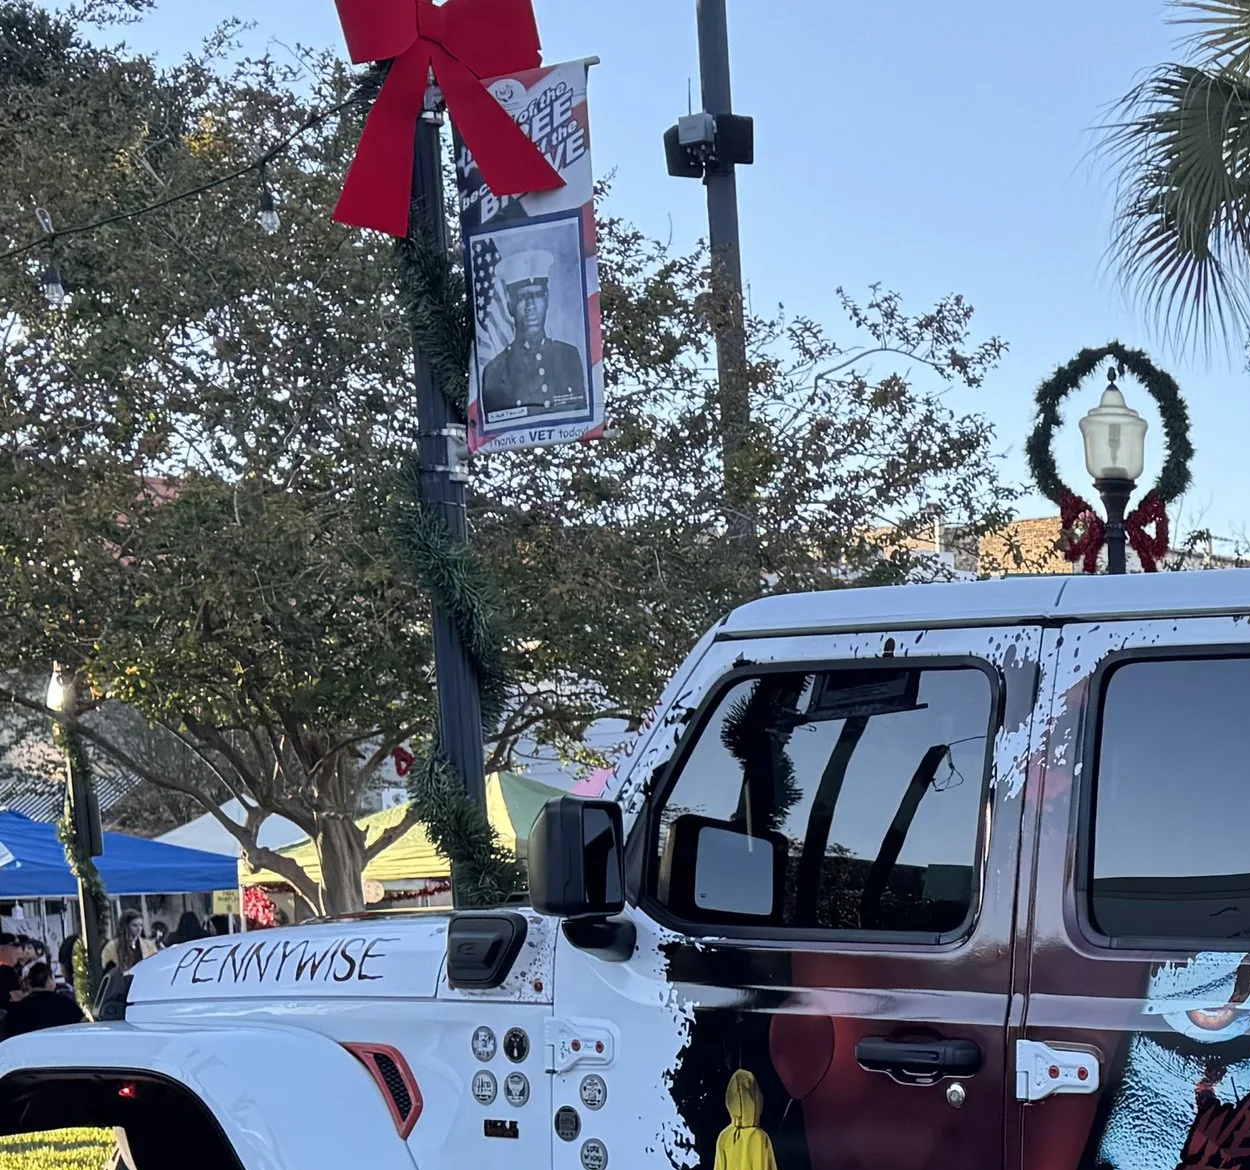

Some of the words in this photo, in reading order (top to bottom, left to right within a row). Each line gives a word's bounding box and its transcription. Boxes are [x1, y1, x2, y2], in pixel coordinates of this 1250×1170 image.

[540, 82, 566, 109] the
[551, 120, 578, 146] the
[519, 435, 525, 444] a
[529, 429, 555, 442] VET
[171, 937, 400, 986] PENNYWISE
